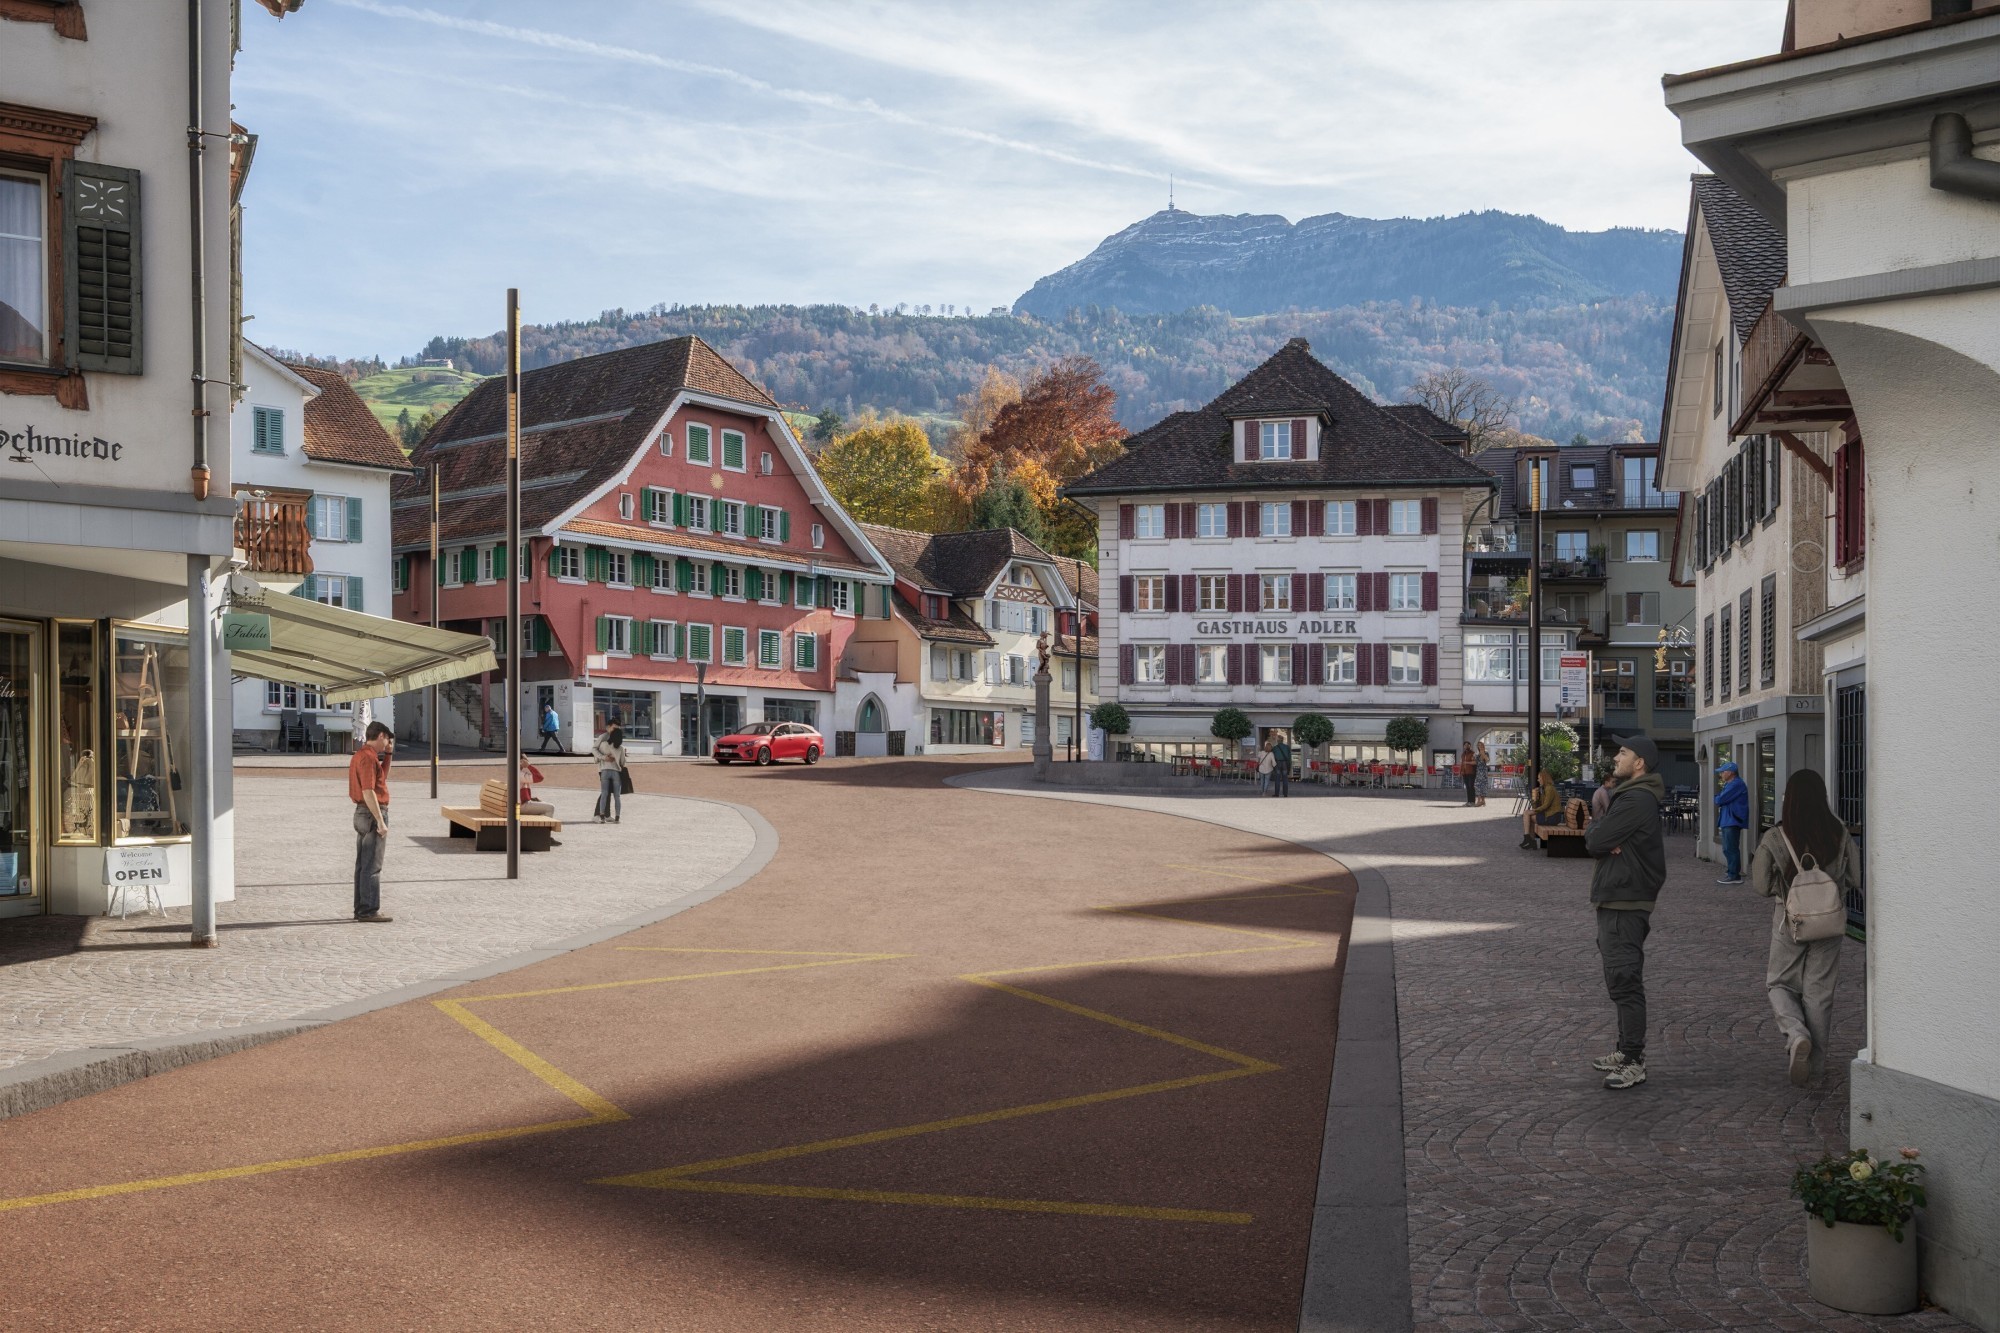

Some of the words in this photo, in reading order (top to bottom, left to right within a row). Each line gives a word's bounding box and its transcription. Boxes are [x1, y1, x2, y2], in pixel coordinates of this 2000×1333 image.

[1197, 621, 1288, 634] GASTHAUS
[1298, 621, 1357, 634] ADLER
[115, 868, 162, 881] OPEN
